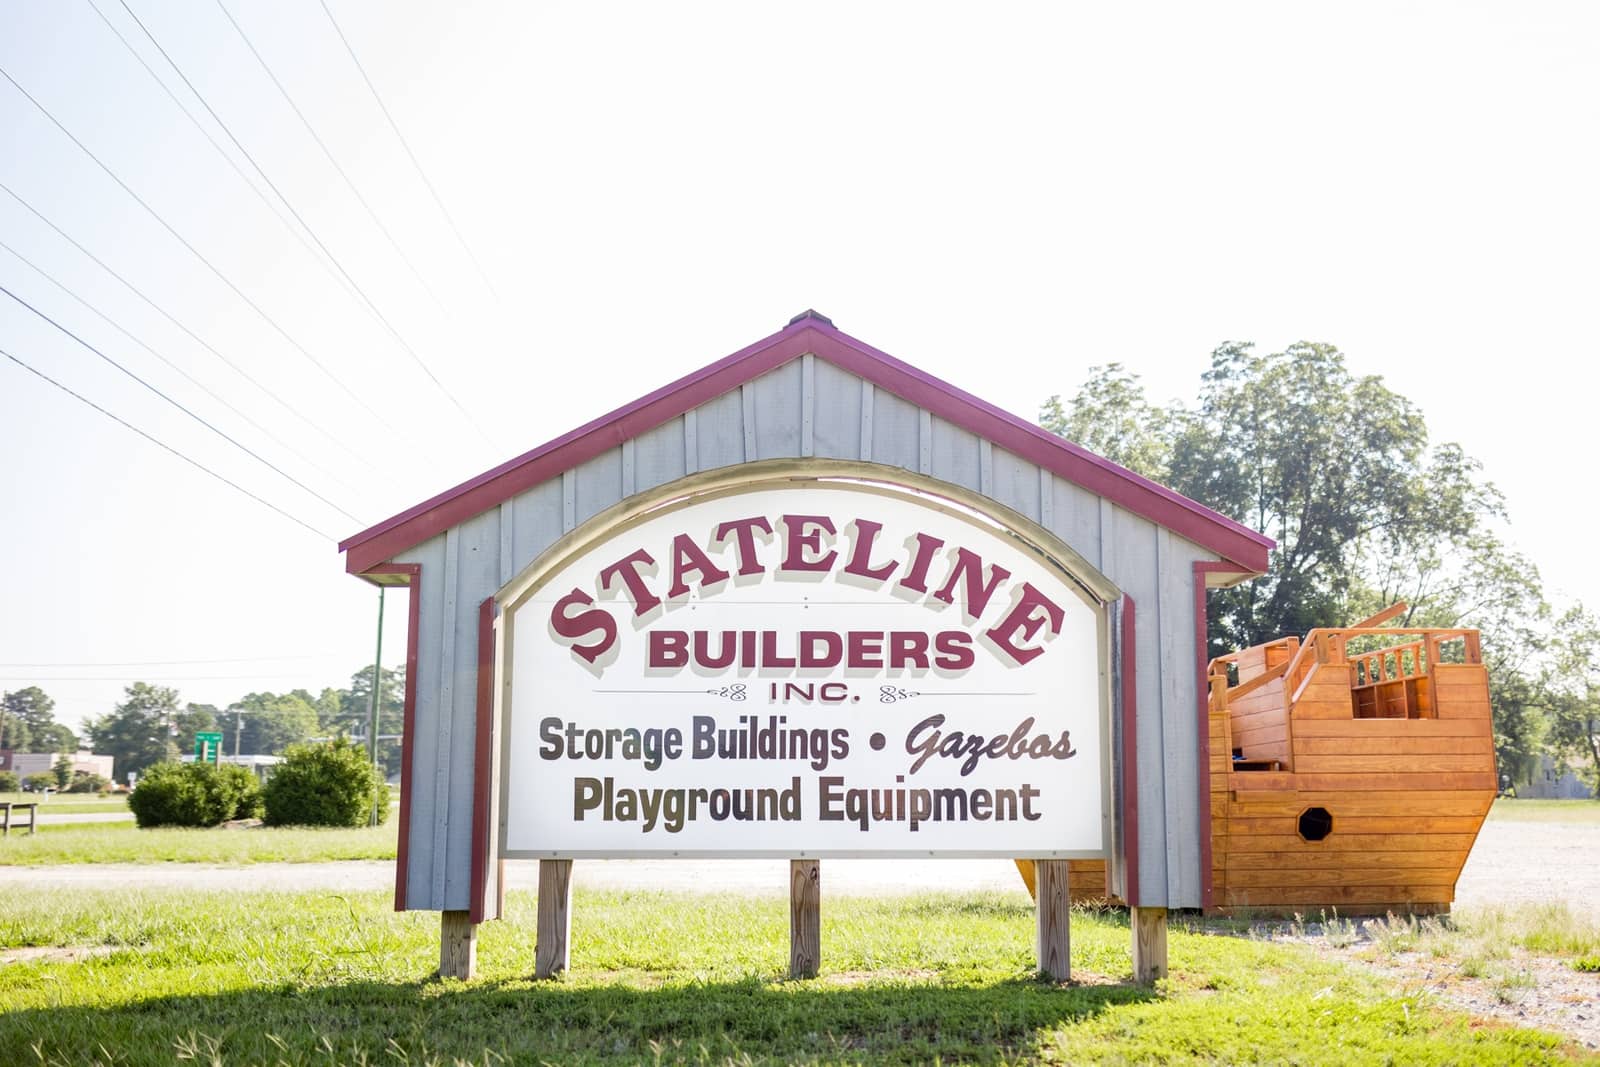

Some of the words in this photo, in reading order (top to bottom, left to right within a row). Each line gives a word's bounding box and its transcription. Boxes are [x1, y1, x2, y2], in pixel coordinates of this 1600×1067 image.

[550, 514, 1065, 667] STATELINE
[647, 630, 976, 670] BUILDERS
[771, 682, 861, 704] INC.
[539, 716, 682, 770] Storage
[692, 716, 849, 770] Buildings
[905, 713, 1077, 778] Gazebos
[573, 776, 802, 833] Playground
[818, 774, 1042, 832] Equipment
